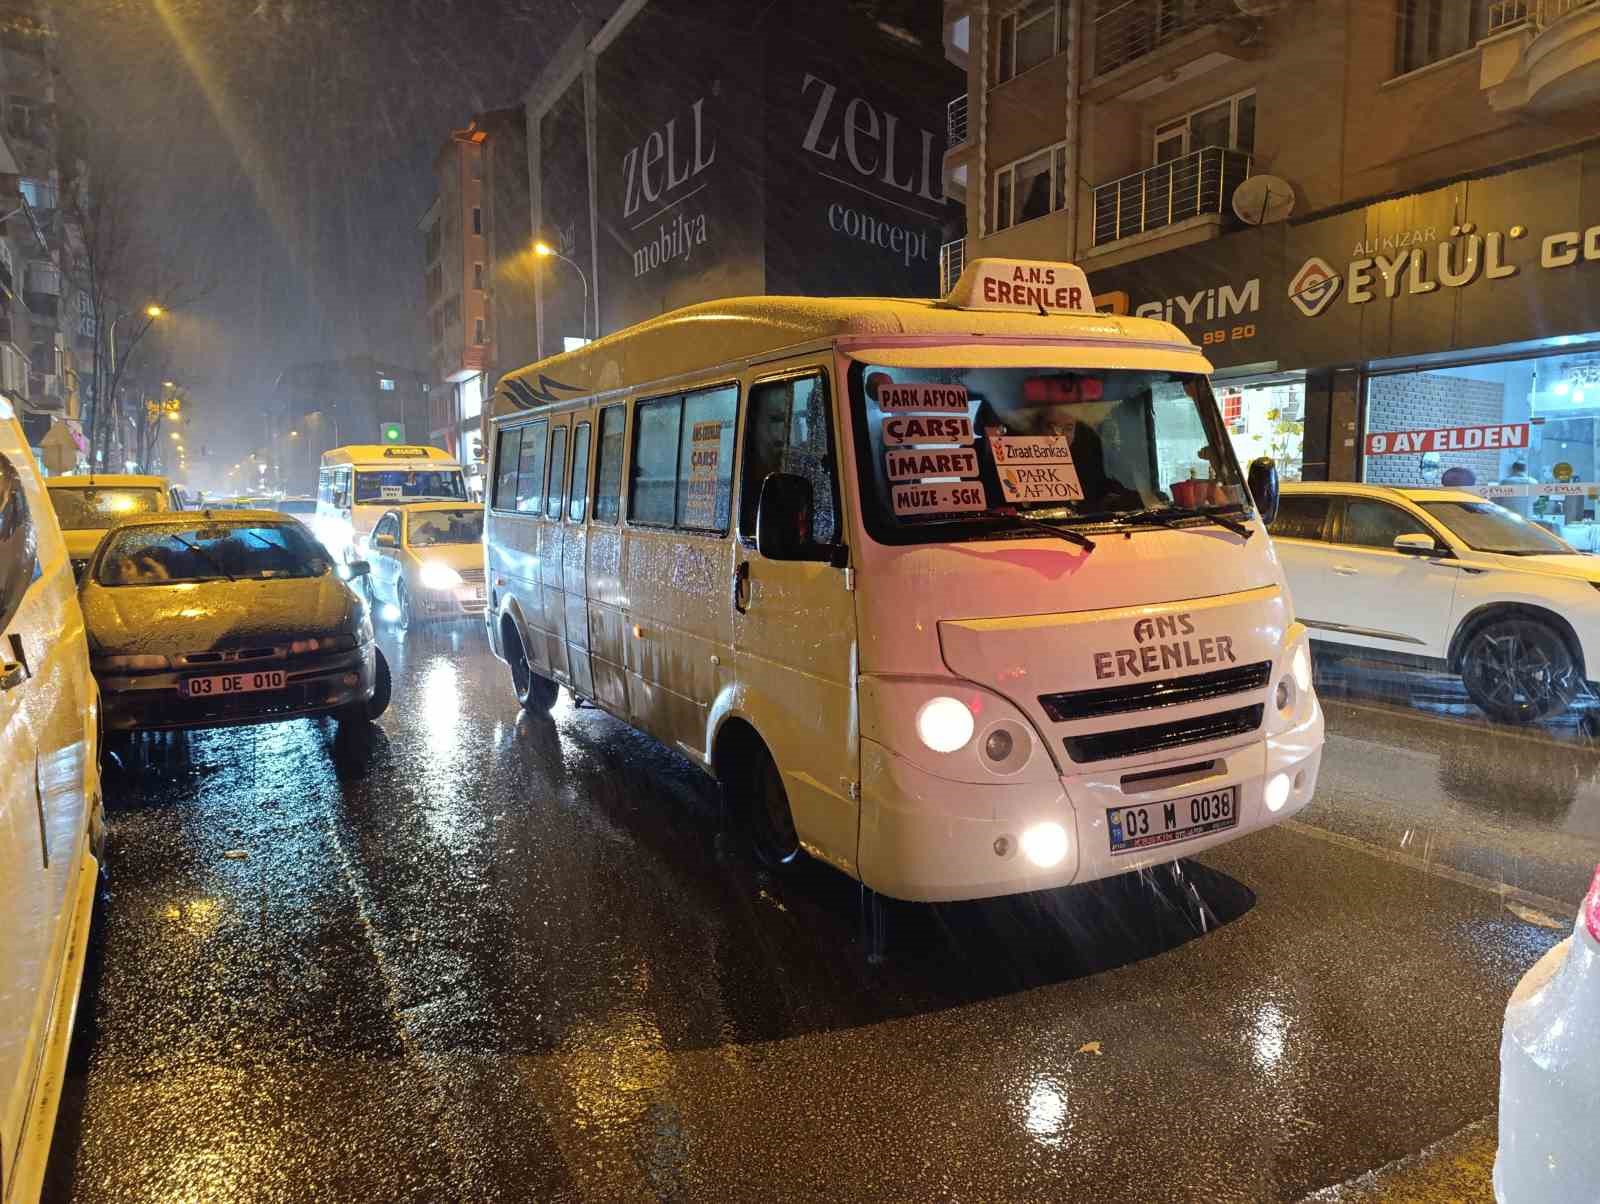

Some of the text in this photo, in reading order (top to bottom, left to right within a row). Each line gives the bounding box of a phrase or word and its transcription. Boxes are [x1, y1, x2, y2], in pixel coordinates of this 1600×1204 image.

[633, 213, 707, 277] mobilya
[828, 203, 928, 267] concept
[1012, 265, 1055, 285] A.N.S
[1347, 223, 1518, 304] EYLÜL
[983, 276, 1082, 310] ERENLER
[1231, 325, 1256, 340] 20
[882, 388, 967, 409] PARK AFYON
[887, 419, 970, 443] ÇARŞI
[1371, 425, 1523, 453] 9 AY ELDEN
[1007, 444, 1033, 459] Ziraat
[889, 453, 974, 476] İMARET
[1016, 468, 1060, 483] PARK
[897, 486, 938, 508] MÜZE
[951, 488, 981, 505] SGK
[1023, 483, 1080, 498] AFYON
[1133, 613, 1194, 643] ANS
[1093, 635, 1236, 680] ERENLER
[191, 679, 212, 694] 03
[222, 676, 243, 691] DE
[253, 672, 281, 688] 010
[1126, 808, 1149, 837] 03
[1163, 802, 1176, 830] M
[1190, 792, 1230, 823] 0038
